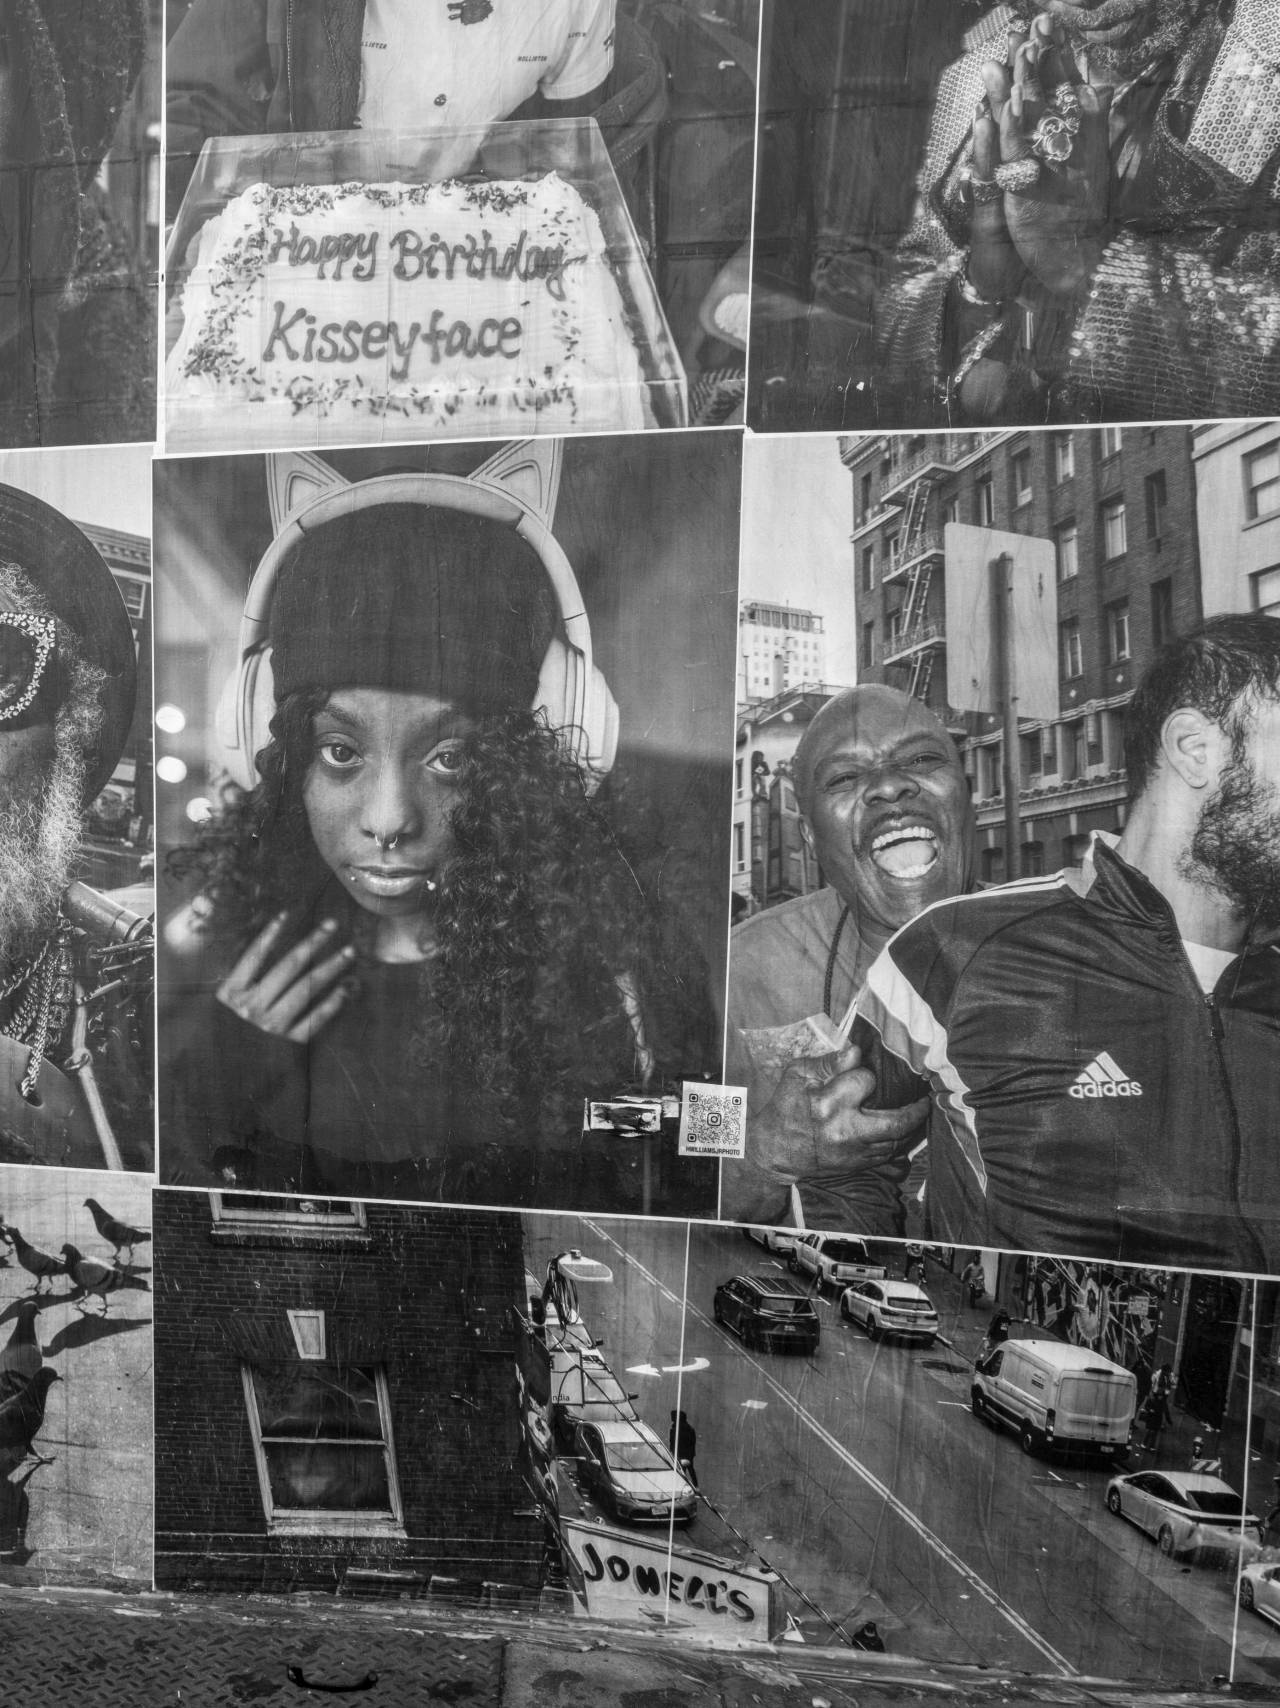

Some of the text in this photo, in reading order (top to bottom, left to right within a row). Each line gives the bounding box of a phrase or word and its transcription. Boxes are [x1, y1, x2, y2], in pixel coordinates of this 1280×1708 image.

[269, 222, 587, 300] Happy Birthday
[1068, 1081, 1143, 1099] adidas
